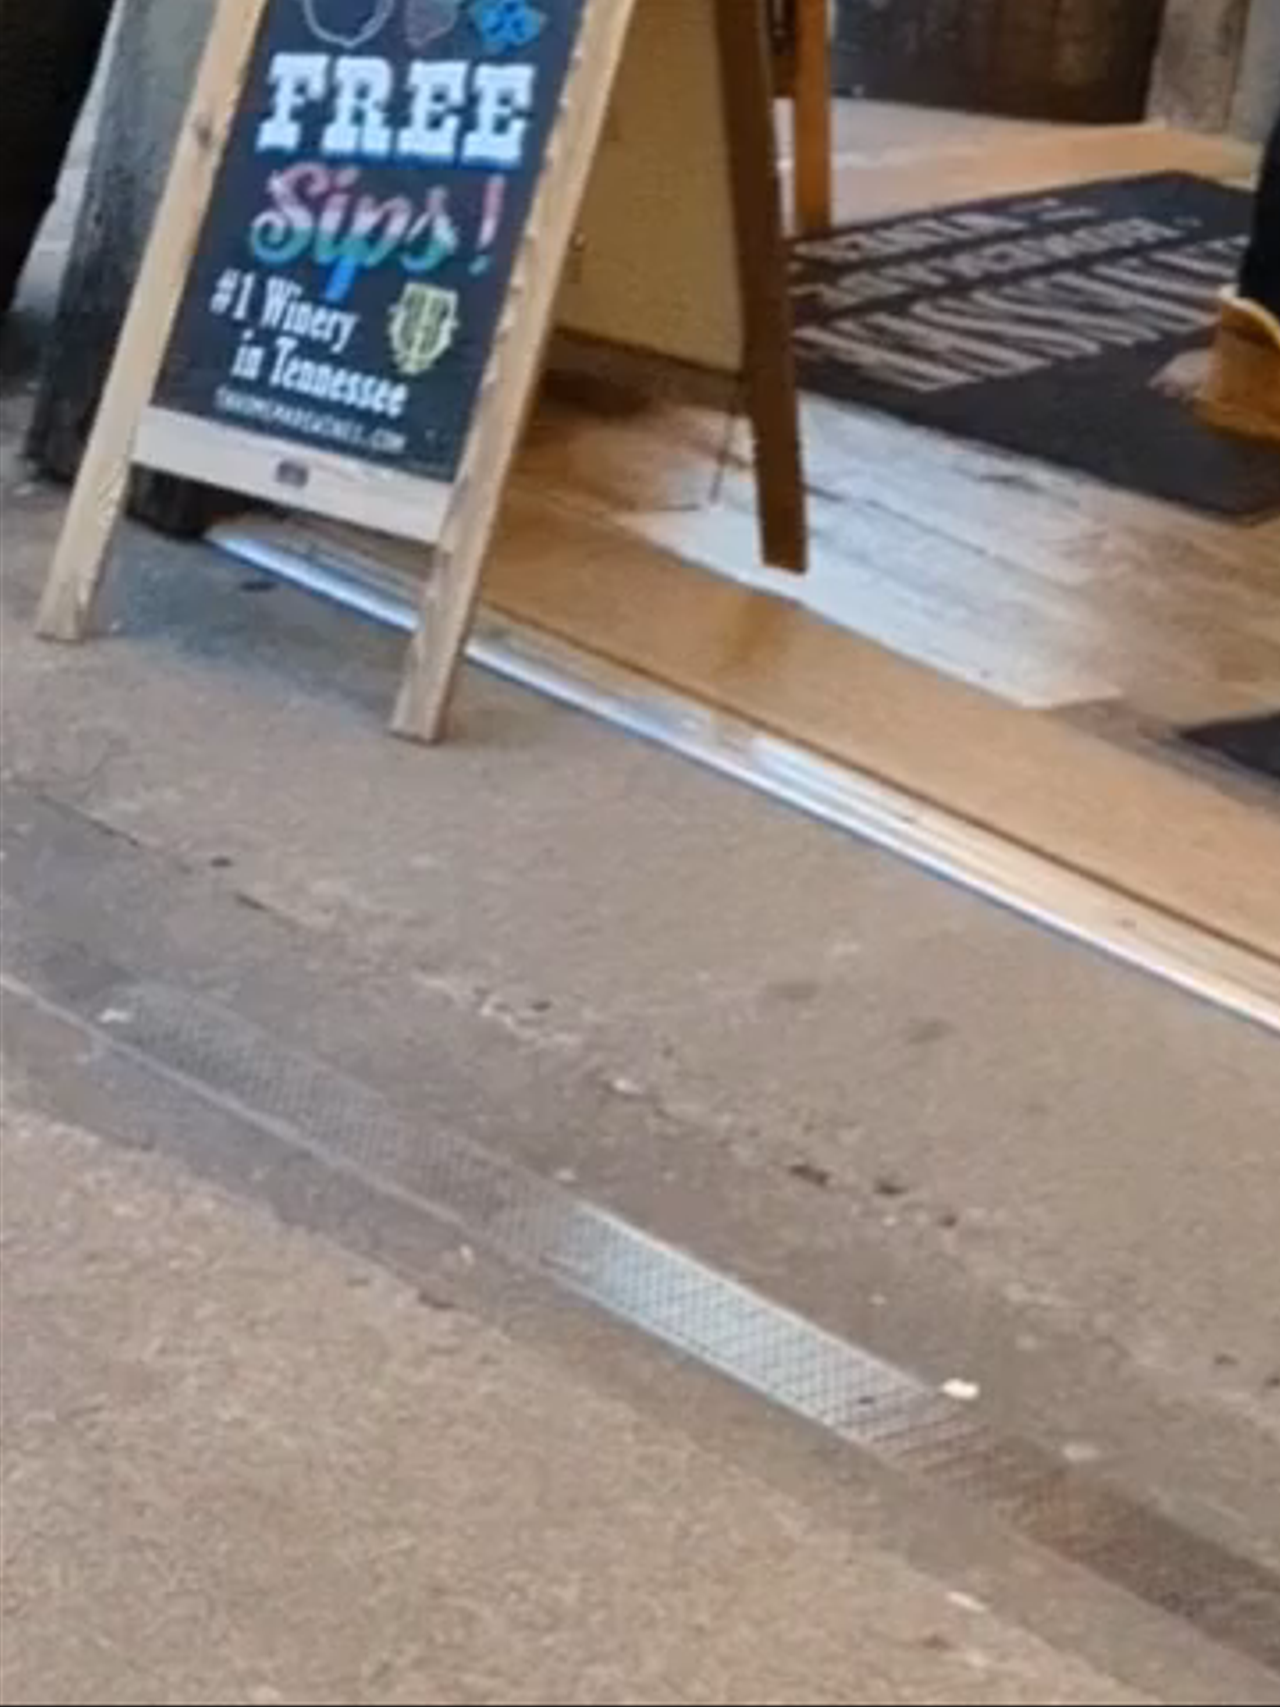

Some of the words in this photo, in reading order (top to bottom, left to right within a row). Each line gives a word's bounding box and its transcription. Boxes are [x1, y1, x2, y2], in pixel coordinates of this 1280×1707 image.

[255, 52, 537, 165] FREE
[251, 161, 505, 302] Sips!
[210, 267, 255, 321] #1
[261, 277, 358, 354] Winery
[231, 329, 264, 381] in
[269, 335, 408, 418] Tennessee
